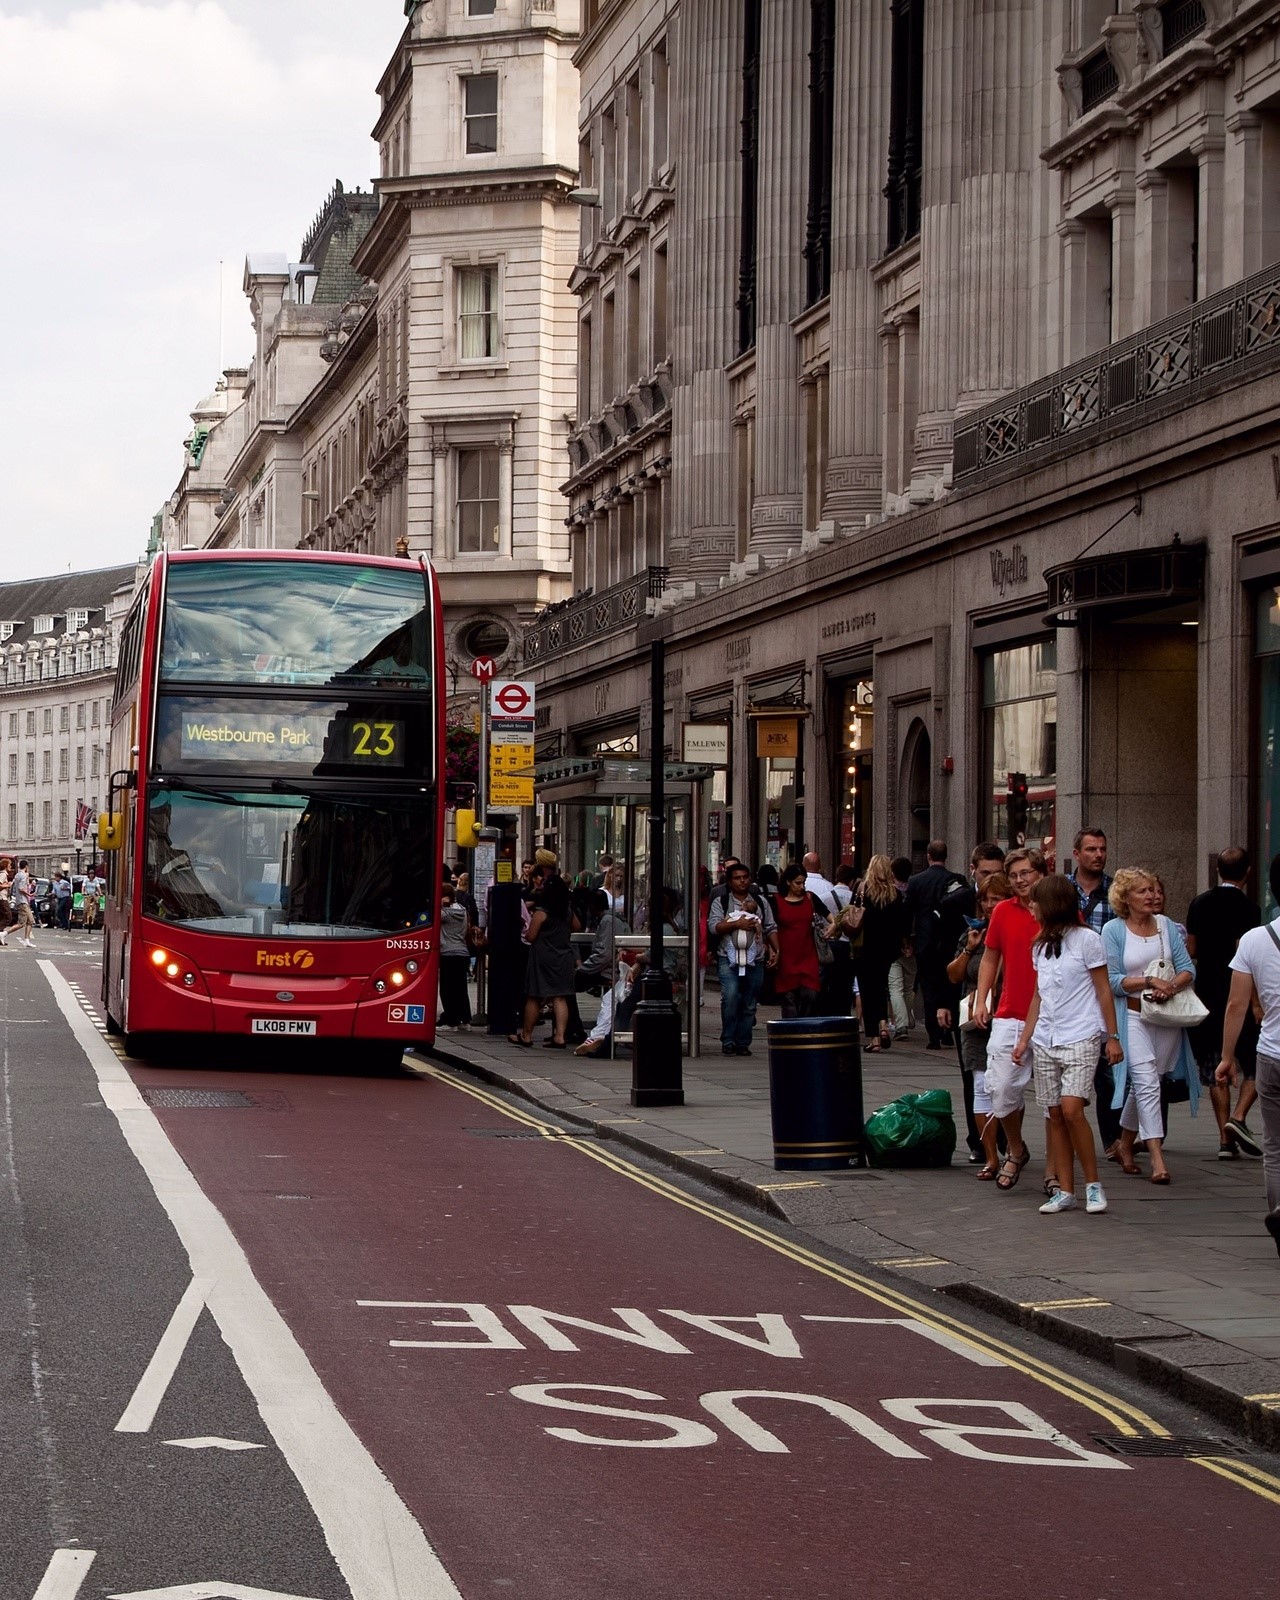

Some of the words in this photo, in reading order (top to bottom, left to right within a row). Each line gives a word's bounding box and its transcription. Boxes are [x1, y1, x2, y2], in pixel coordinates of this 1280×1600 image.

[476, 660, 493, 676] M
[187, 723, 275, 743] Westbourne
[280, 727, 311, 745] Park
[352, 722, 395, 756] 23
[386, 939, 431, 950] DN33513
[256, 950, 291, 967] First
[256, 1021, 286, 1032] LK08
[288, 1021, 311, 1033] FMV
[356, 1300, 1007, 1367] LANE
[508, 1381, 1132, 1469] BUS
